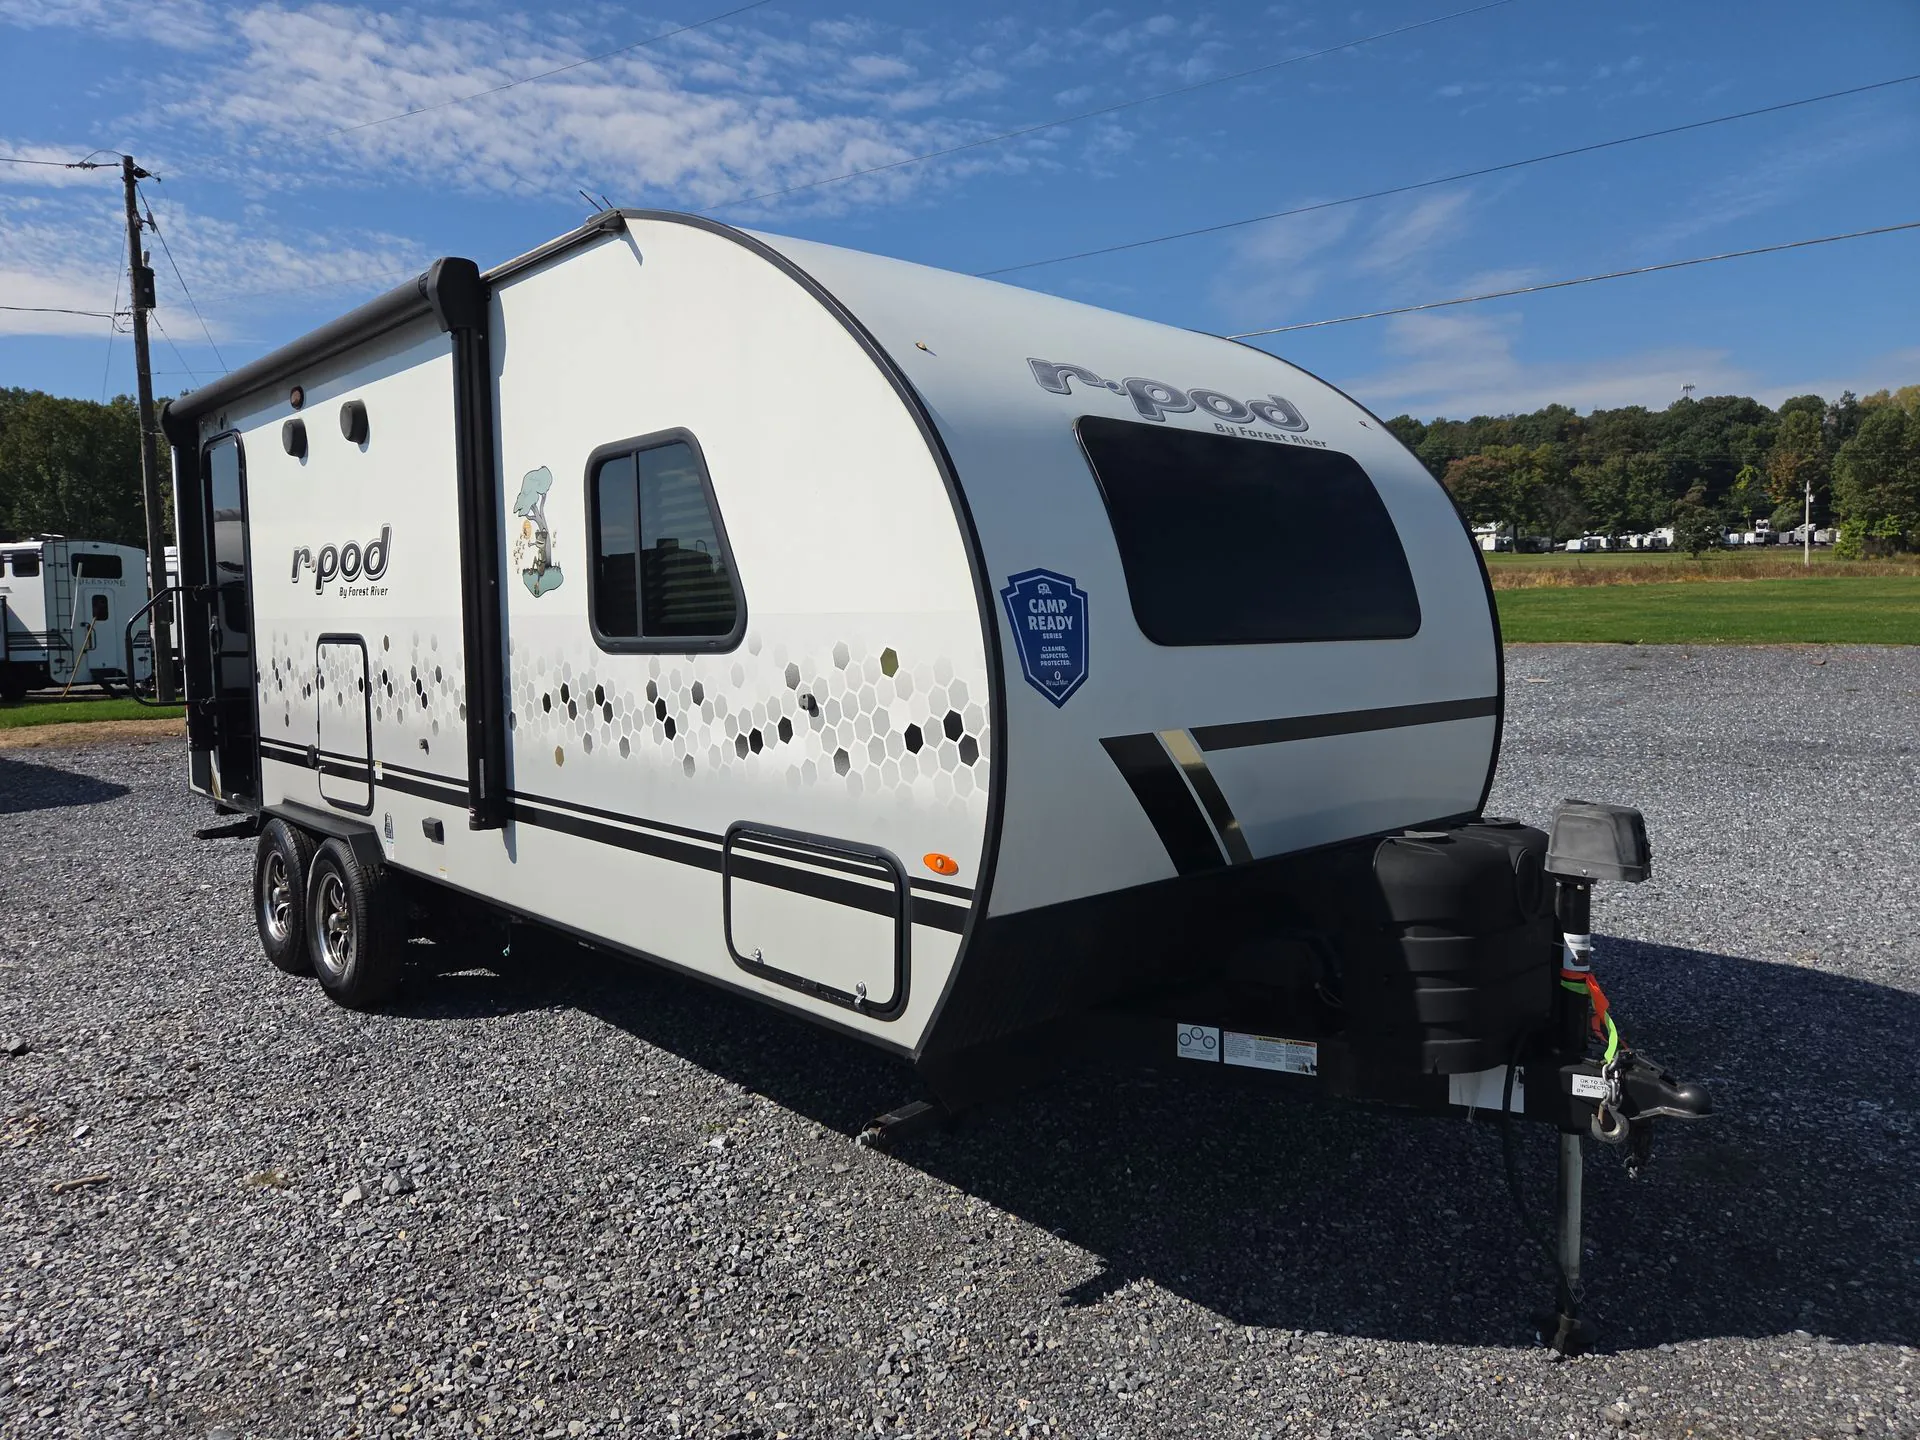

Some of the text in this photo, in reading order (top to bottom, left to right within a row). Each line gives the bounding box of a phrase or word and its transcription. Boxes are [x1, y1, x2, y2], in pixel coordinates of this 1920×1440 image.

[1213, 422, 1327, 448] By Forest River
[339, 585, 389, 598] By Forest River
[1028, 598, 1068, 614] CAMP
[1028, 616, 1073, 630] READY
